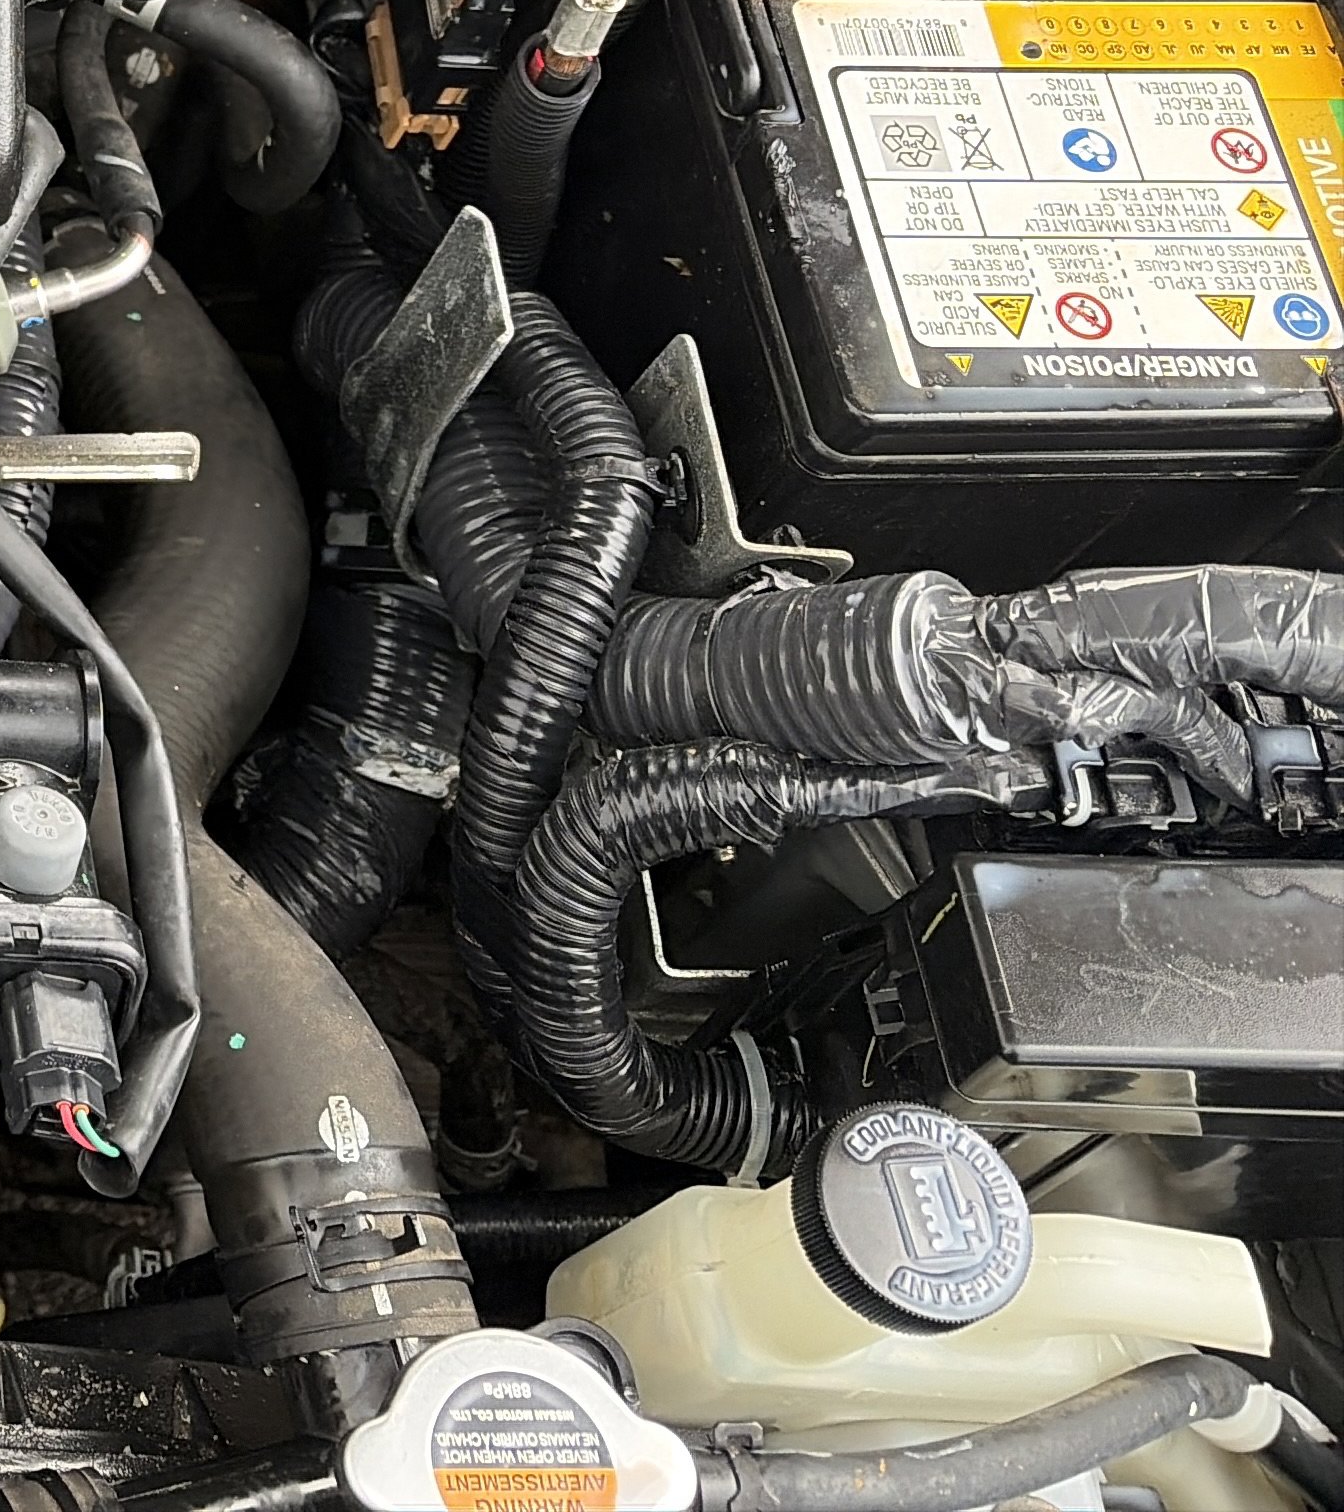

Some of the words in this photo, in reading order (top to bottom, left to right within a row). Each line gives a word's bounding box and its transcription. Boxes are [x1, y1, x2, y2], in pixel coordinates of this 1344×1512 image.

[1075, 19, 1083, 30] 9
[1102, 19, 1110, 30] 8
[1130, 20, 1140, 30] 7
[1156, 20, 1165, 30] 6
[1184, 20, 1193, 30] 5
[1212, 20, 1221, 30] 4
[1240, 20, 1249, 30] 3
[1266, 20, 1277, 30] 2
[1078, 44, 1095, 55] OC
[1108, 44, 1124, 55] SP
[1190, 44, 1205, 55] JU
[1215, 44, 1235, 55] MA
[1245, 44, 1261, 55] AP
[1273, 44, 1290, 55] MR
[1302, 44, 1317, 55] FE
[864, 77, 949, 90] RECYCLED.
[952, 78, 972, 91] BE
[1041, 78, 1096, 91] TIONS.
[1223, 82, 1242, 95] OF
[866, 91, 910, 105] MUST
[914, 92, 982, 106] BATTERY
[1026, 93, 1100, 107] INSTRUC-
[1159, 97, 1212, 110] REACH
[1218, 97, 1250, 110] THE
[955, 114, 977, 124] Pb
[1063, 108, 1106, 122] READ
[1154, 112, 1174, 125] OF
[1179, 112, 1210, 125] OUT
[1215, 112, 1255, 125] KEEP
[903, 140, 918, 148] Pb
[904, 186, 954, 199] OPEN.
[1094, 188, 1138, 201] FAST.
[1143, 188, 1183, 201] HELP
[1187, 188, 1219, 201] CAL
[1297, 136, 1344, 253] OTIVE
[906, 201, 928, 215] OR
[935, 202, 960, 215] TIP
[1033, 203, 1080, 216] MEDI-
[1084, 203, 1115, 216] GET
[1186, 204, 1227, 217] WITH
[906, 218, 936, 231] NOT
[942, 218, 965, 231] DO
[1025, 218, 1131, 232] IMMEDIATELY
[1135, 219, 1174, 232] EYES
[1178, 219, 1232, 232] FLUSH
[1034, 244, 1099, 256] SMOKING
[1207, 245, 1224, 257] OR
[1225, 245, 1307, 257] BLINDNESS
[949, 258, 1003, 271] SEVERE
[1007, 259, 1025, 271] OR
[1047, 258, 1105, 270] FLAMES
[1134, 259, 1180, 272] CAUSE
[1184, 260, 1214, 273] CAN
[1220, 260, 1272, 274] GASES
[1279, 261, 1312, 274] SIVE
[902, 274, 981, 287] BLINDNESS
[983, 274, 1030, 287] CAUSE
[1055, 272, 1110, 284] SPARKS
[1149, 276, 1206, 290] EXPLO-
[1260, 277, 1318, 291] SHIELD
[933, 290, 964, 302] CAN
[1099, 287, 1124, 300] NO
[942, 306, 980, 319] ACID
[917, 321, 998, 335] SULFURIC
[1023, 354, 1259, 377] DANGER/POISON
[334, 1099, 355, 1159] NISSAN
[845, 1113, 948, 1157] COOLANT
[953, 1131, 1014, 1209] LIQUID
[893, 1213, 1021, 1306] REFRIGERANT
[483, 1382, 532, 1399] 88kPa
[495, 1409, 533, 1422] MOTOR
[534, 1409, 575, 1422] NISSAN
[434, 1432, 480, 1446] CHAUD.
[493, 1432, 538, 1446] OUVRIR
[539, 1432, 581, 1446] JAMAIS
[582, 1432, 600, 1446] NE
[442, 1449, 472, 1464] HOT.
[475, 1449, 517, 1464] WHEN
[518, 1450, 552, 1464] OPEN
[557, 1450, 600, 1464] NEVER
[445, 1473, 606, 1492] AVERTISSEMENT
[475, 1497, 585, 1512] WARNING
